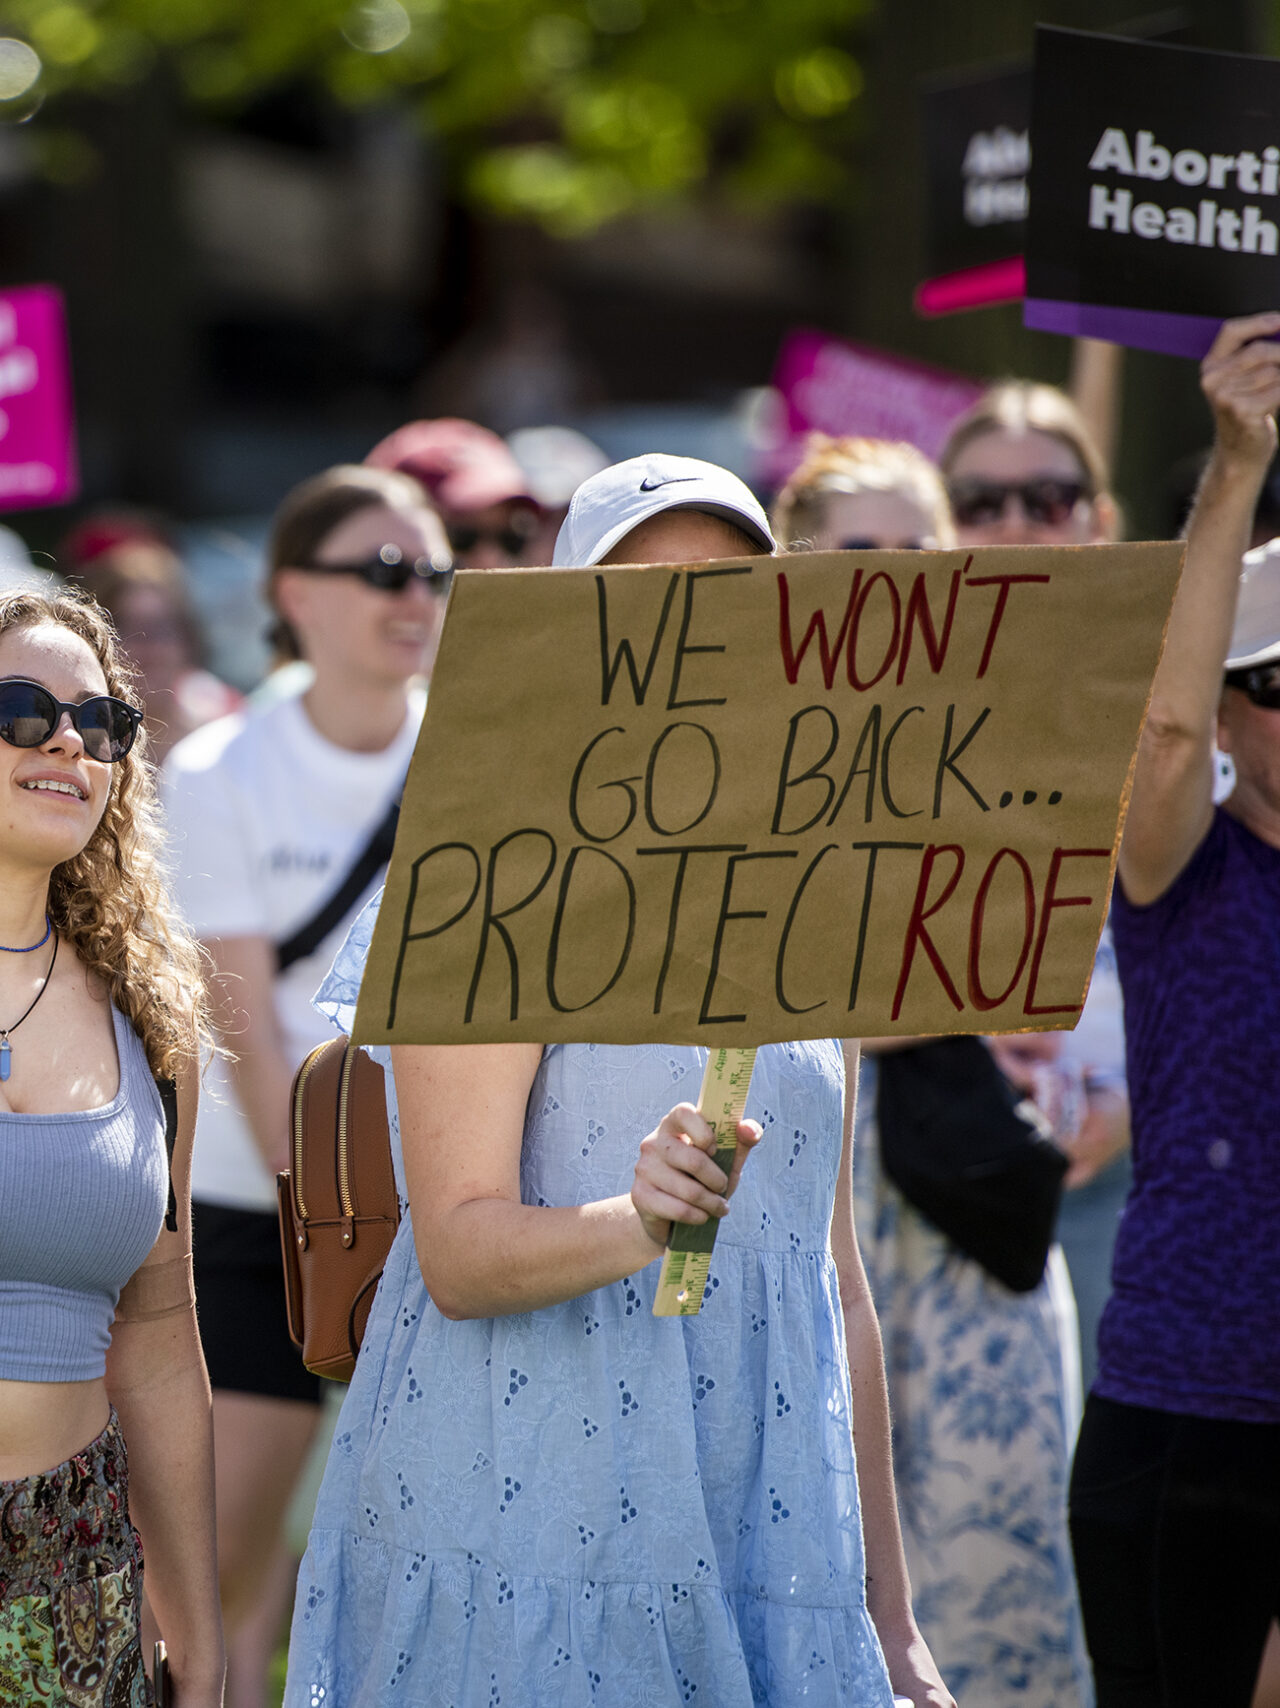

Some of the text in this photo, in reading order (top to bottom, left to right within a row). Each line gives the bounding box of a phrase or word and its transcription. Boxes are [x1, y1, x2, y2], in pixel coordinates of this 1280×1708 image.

[1088, 184, 1280, 256] Health
[595, 555, 1050, 710] WE WON'T
[569, 703, 1063, 843] GO BACK...
[387, 828, 1111, 1030] PROTECT ROE
